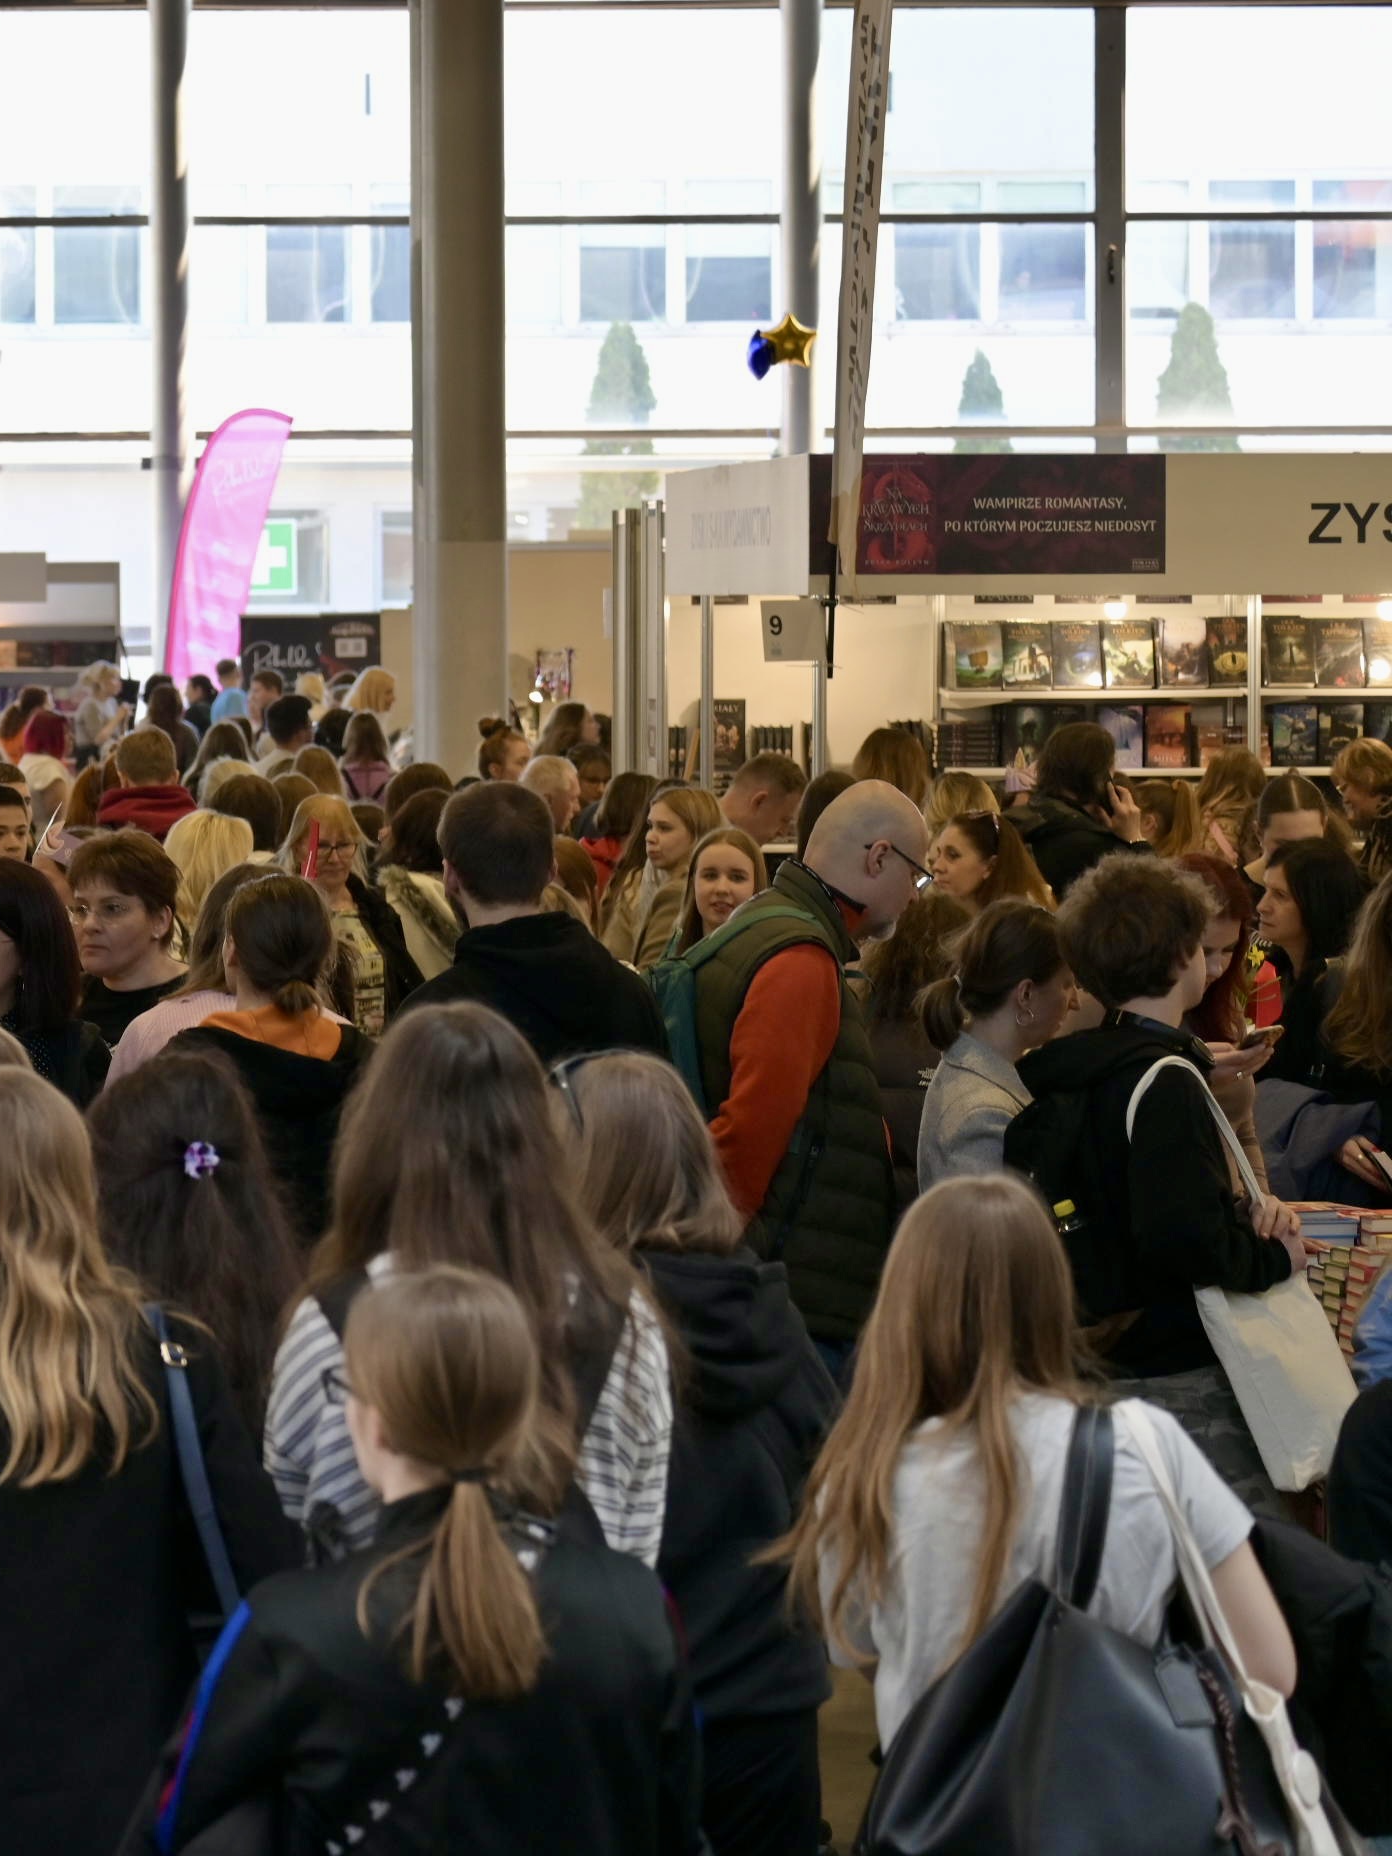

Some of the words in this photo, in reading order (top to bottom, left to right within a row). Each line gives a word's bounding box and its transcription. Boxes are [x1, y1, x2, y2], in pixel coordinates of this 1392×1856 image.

[973, 497, 1042, 509] WAMPIRZE
[1045, 497, 1127, 510] ROMANTASY,
[944, 520, 961, 532] PO
[964, 518, 1017, 532] KTÓRYM
[1020, 520, 1092, 532] POCZUJESZ
[1094, 520, 1157, 532] NIEDOSYT
[769, 615, 783, 635] 9
